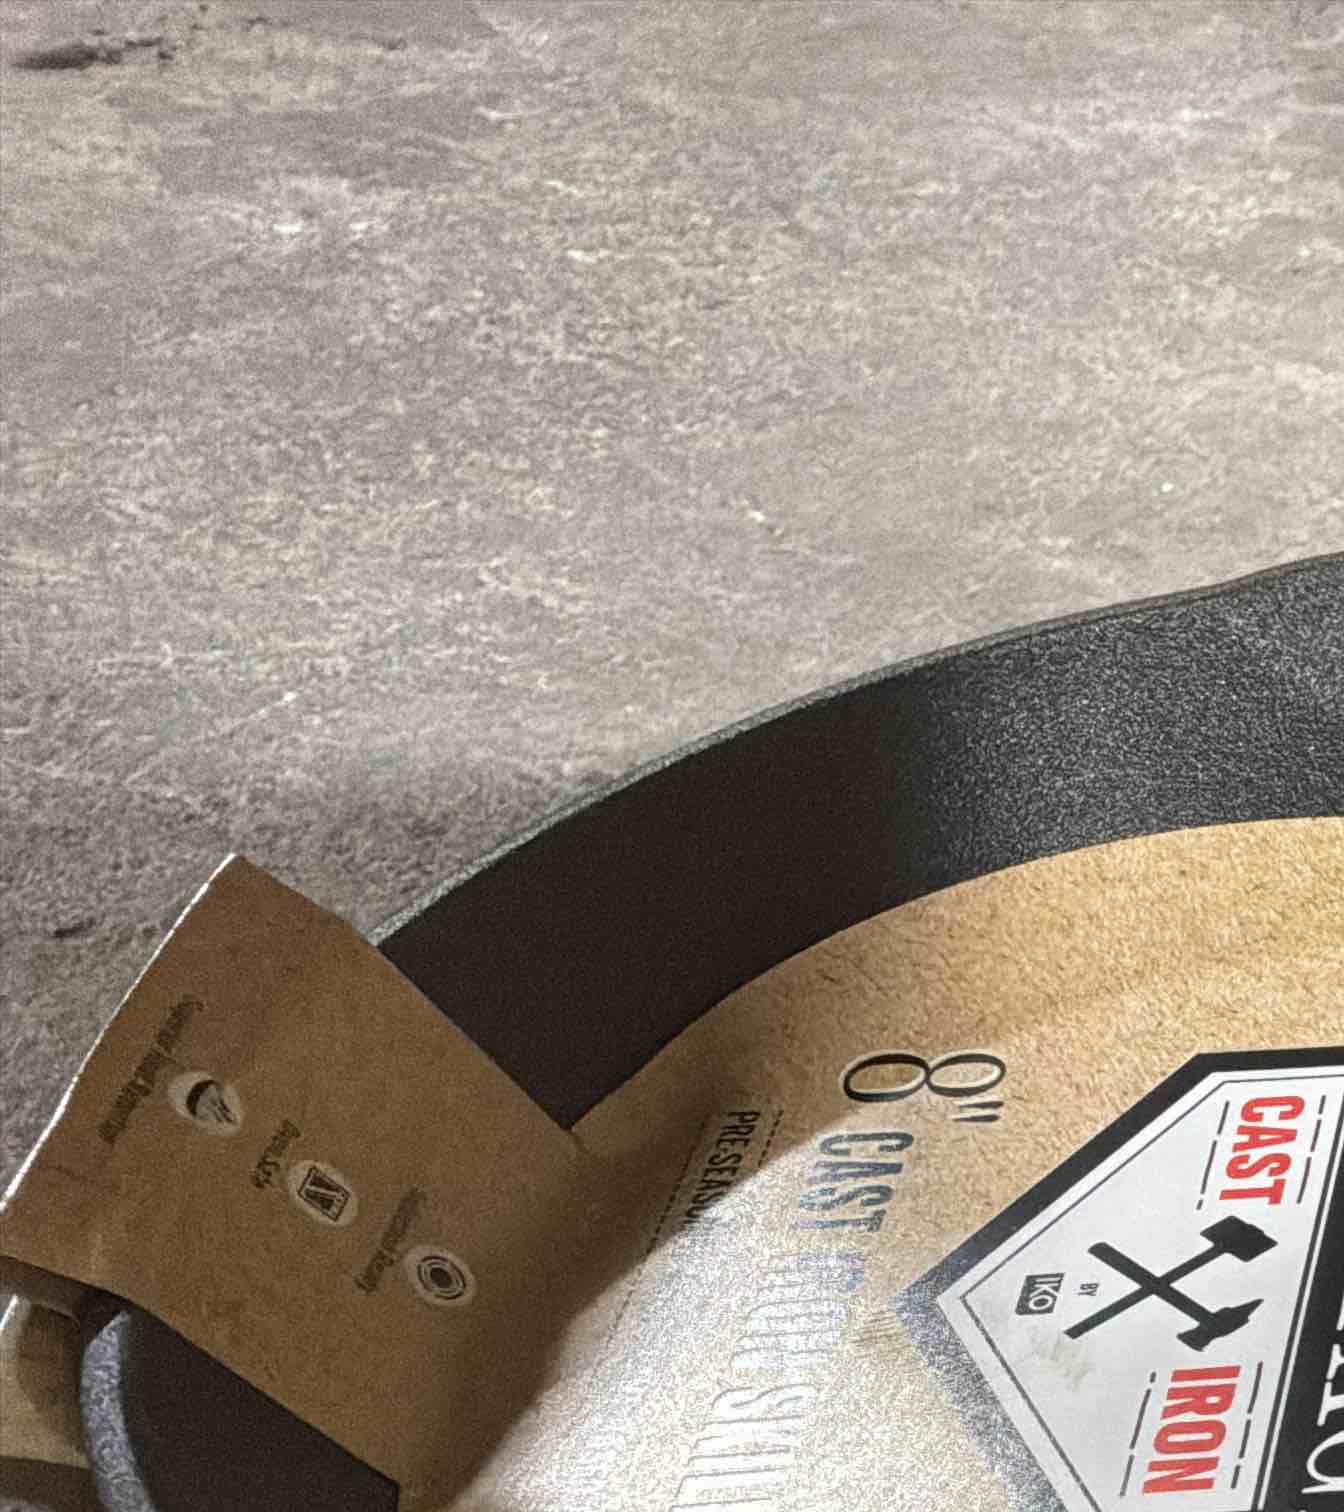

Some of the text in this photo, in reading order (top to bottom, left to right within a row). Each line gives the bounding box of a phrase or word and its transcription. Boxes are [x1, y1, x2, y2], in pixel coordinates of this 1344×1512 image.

[793, 1131, 915, 1233] CAST
[1219, 1095, 1305, 1205] CAST
[1016, 1273, 1064, 1315] IKO
[1079, 1282, 1099, 1298] BY
[1141, 1364, 1242, 1496] IRON
